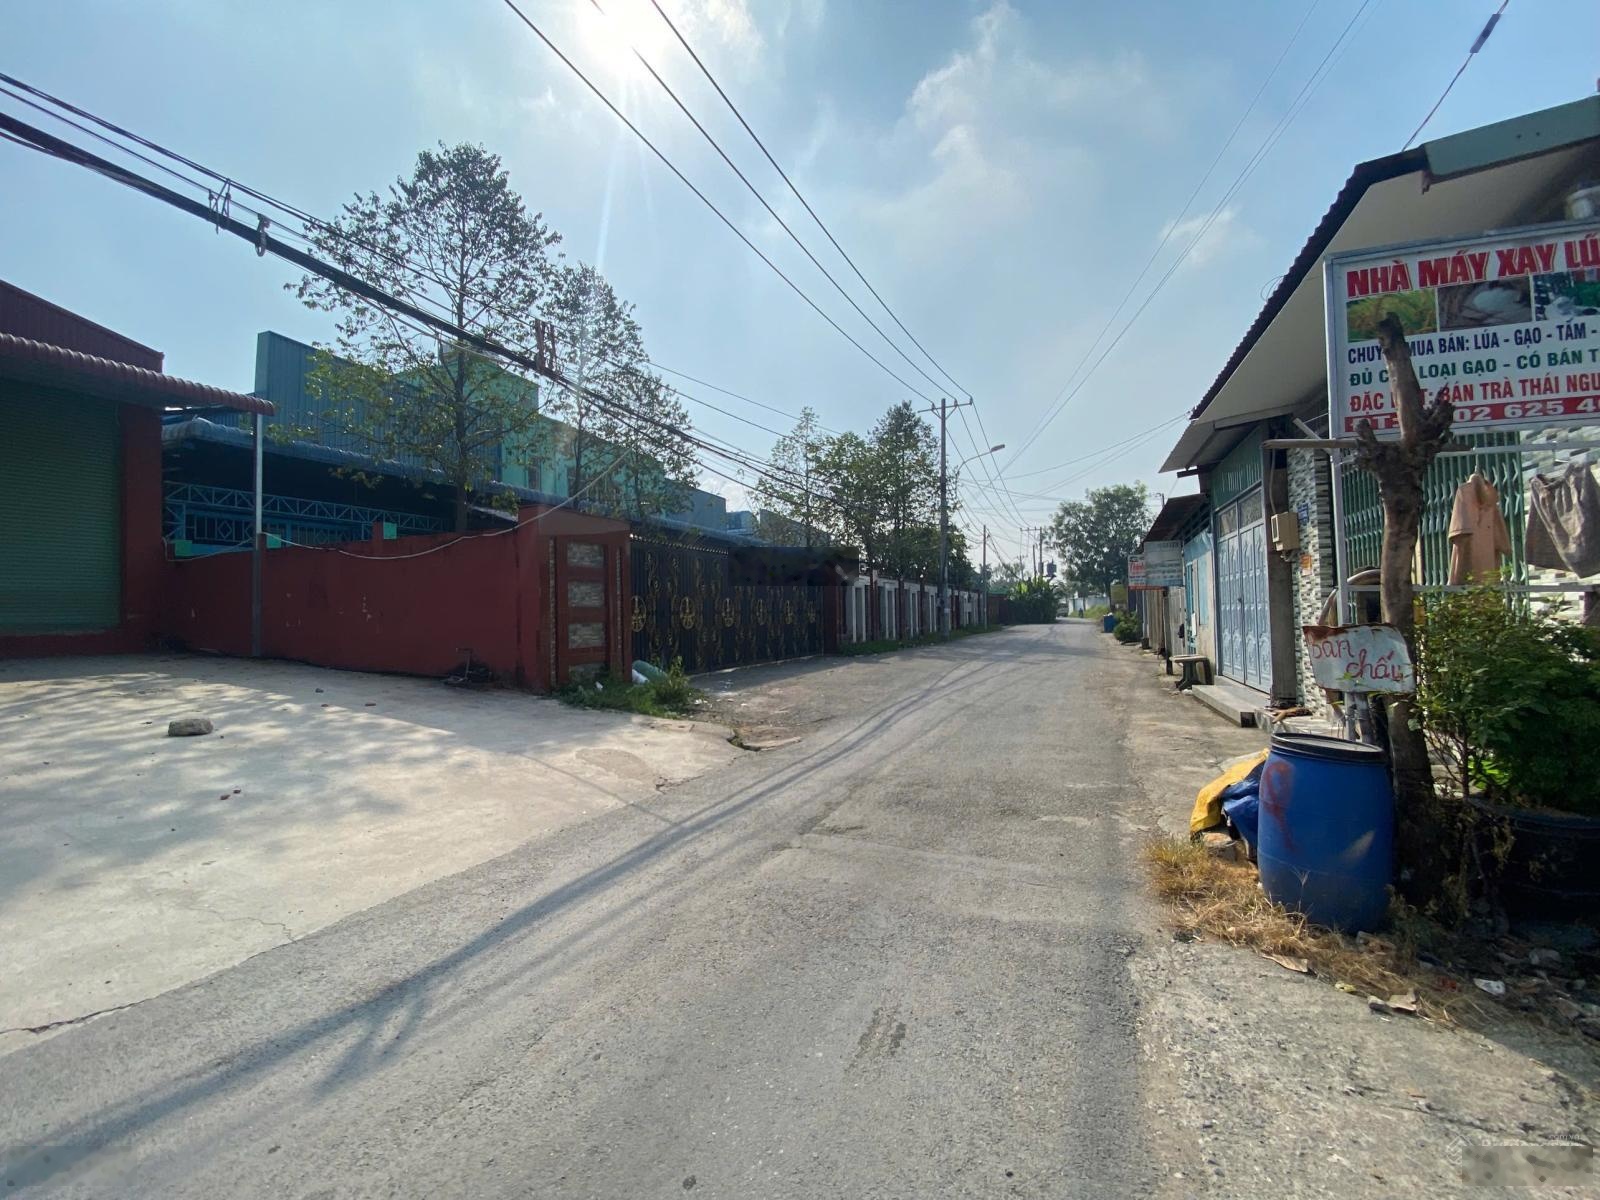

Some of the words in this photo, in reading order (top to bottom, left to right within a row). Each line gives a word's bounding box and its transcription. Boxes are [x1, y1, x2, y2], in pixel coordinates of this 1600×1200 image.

[1346, 260, 1412, 298] NHÀ
[1418, 248, 1490, 288] MÁY
[1496, 242, 1557, 277] XAY
[1348, 345, 1383, 364] CHUY
[1439, 332, 1469, 354] BÁN:
[1474, 329, 1500, 350] LÚA
[1514, 327, 1542, 349] GẠO
[1556, 317, 1586, 341] TẤM
[1350, 367, 1373, 387] ĐỦ
[1418, 362, 1456, 380] LOẠI
[1462, 358, 1497, 377] GẠO
[1516, 350, 1541, 370] CÓ
[1547, 347, 1583, 367] BÁN
[1350, 390, 1385, 414] ĐẶC
[1479, 376, 1514, 400] TRÀ
[1519, 371, 1560, 397] THÁI
[1504, 400, 1564, 418] 625
